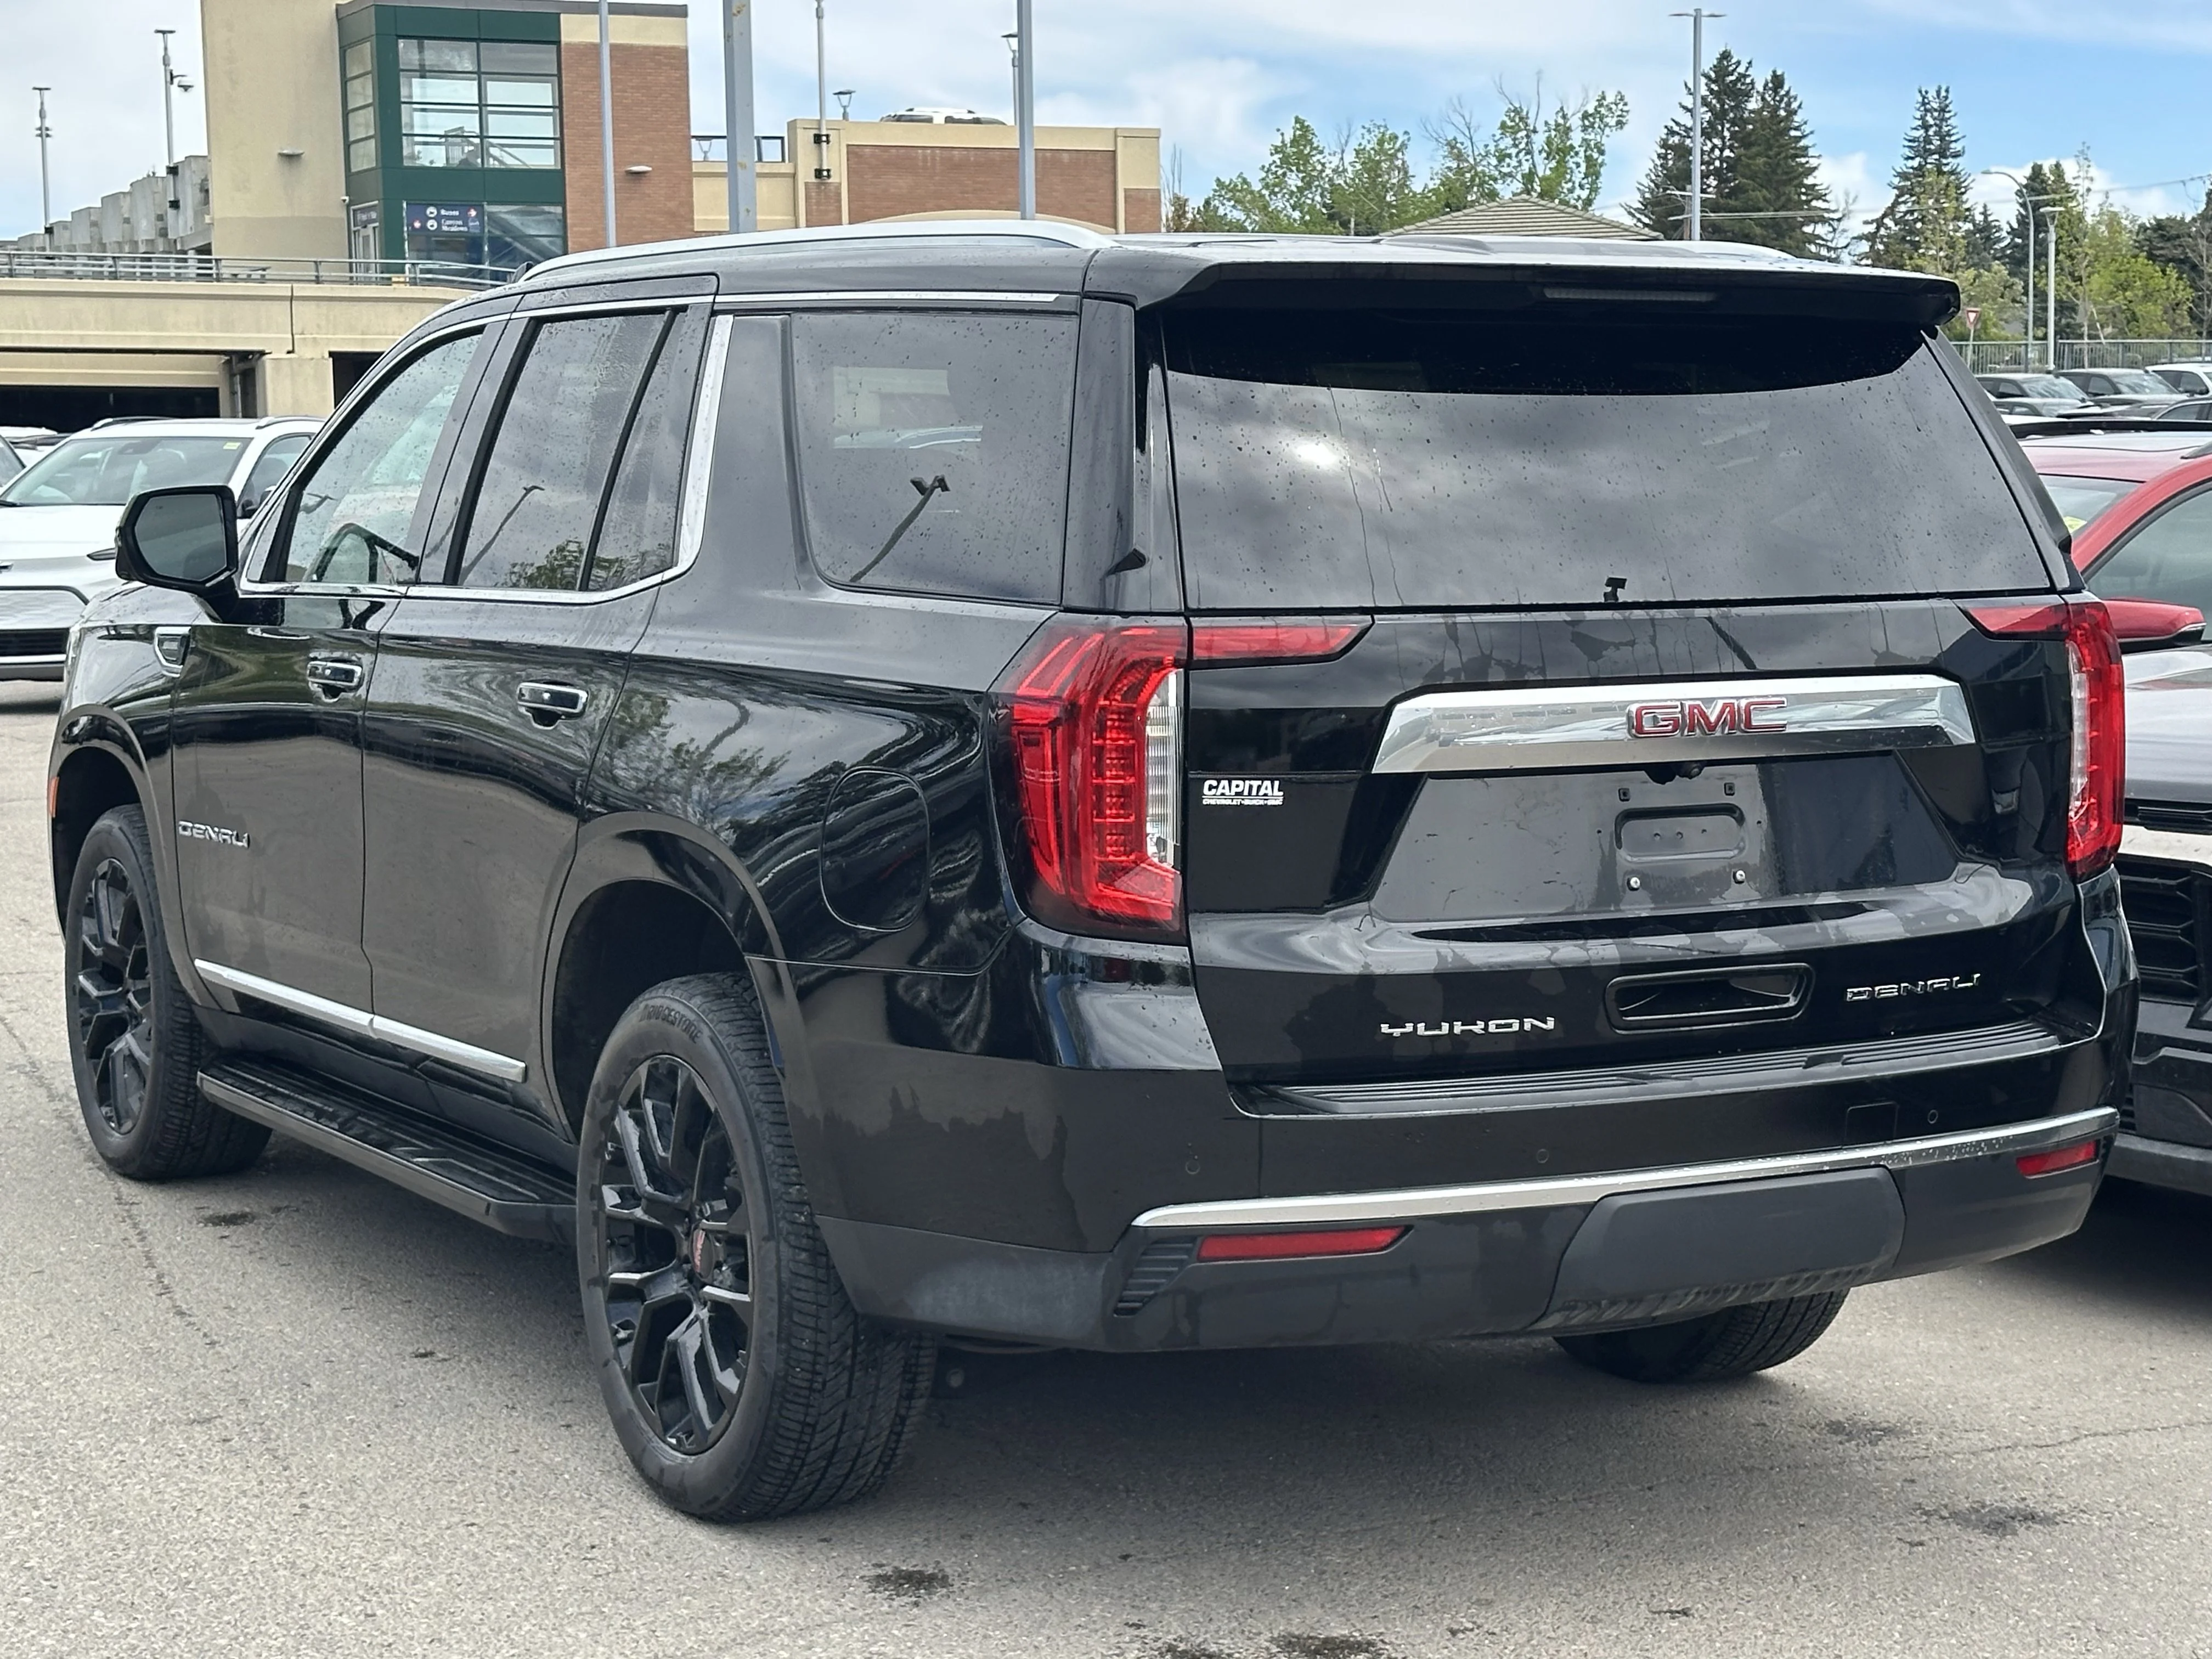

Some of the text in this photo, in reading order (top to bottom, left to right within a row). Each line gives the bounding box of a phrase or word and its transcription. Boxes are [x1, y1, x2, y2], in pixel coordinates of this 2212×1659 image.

[1626, 697, 1787, 738] GMC
[1203, 780, 1283, 795] CAPITAL
[178, 821, 250, 849] DENALI
[1846, 973, 1980, 1002] DENALI
[1380, 1017, 1554, 1037] YUKON
